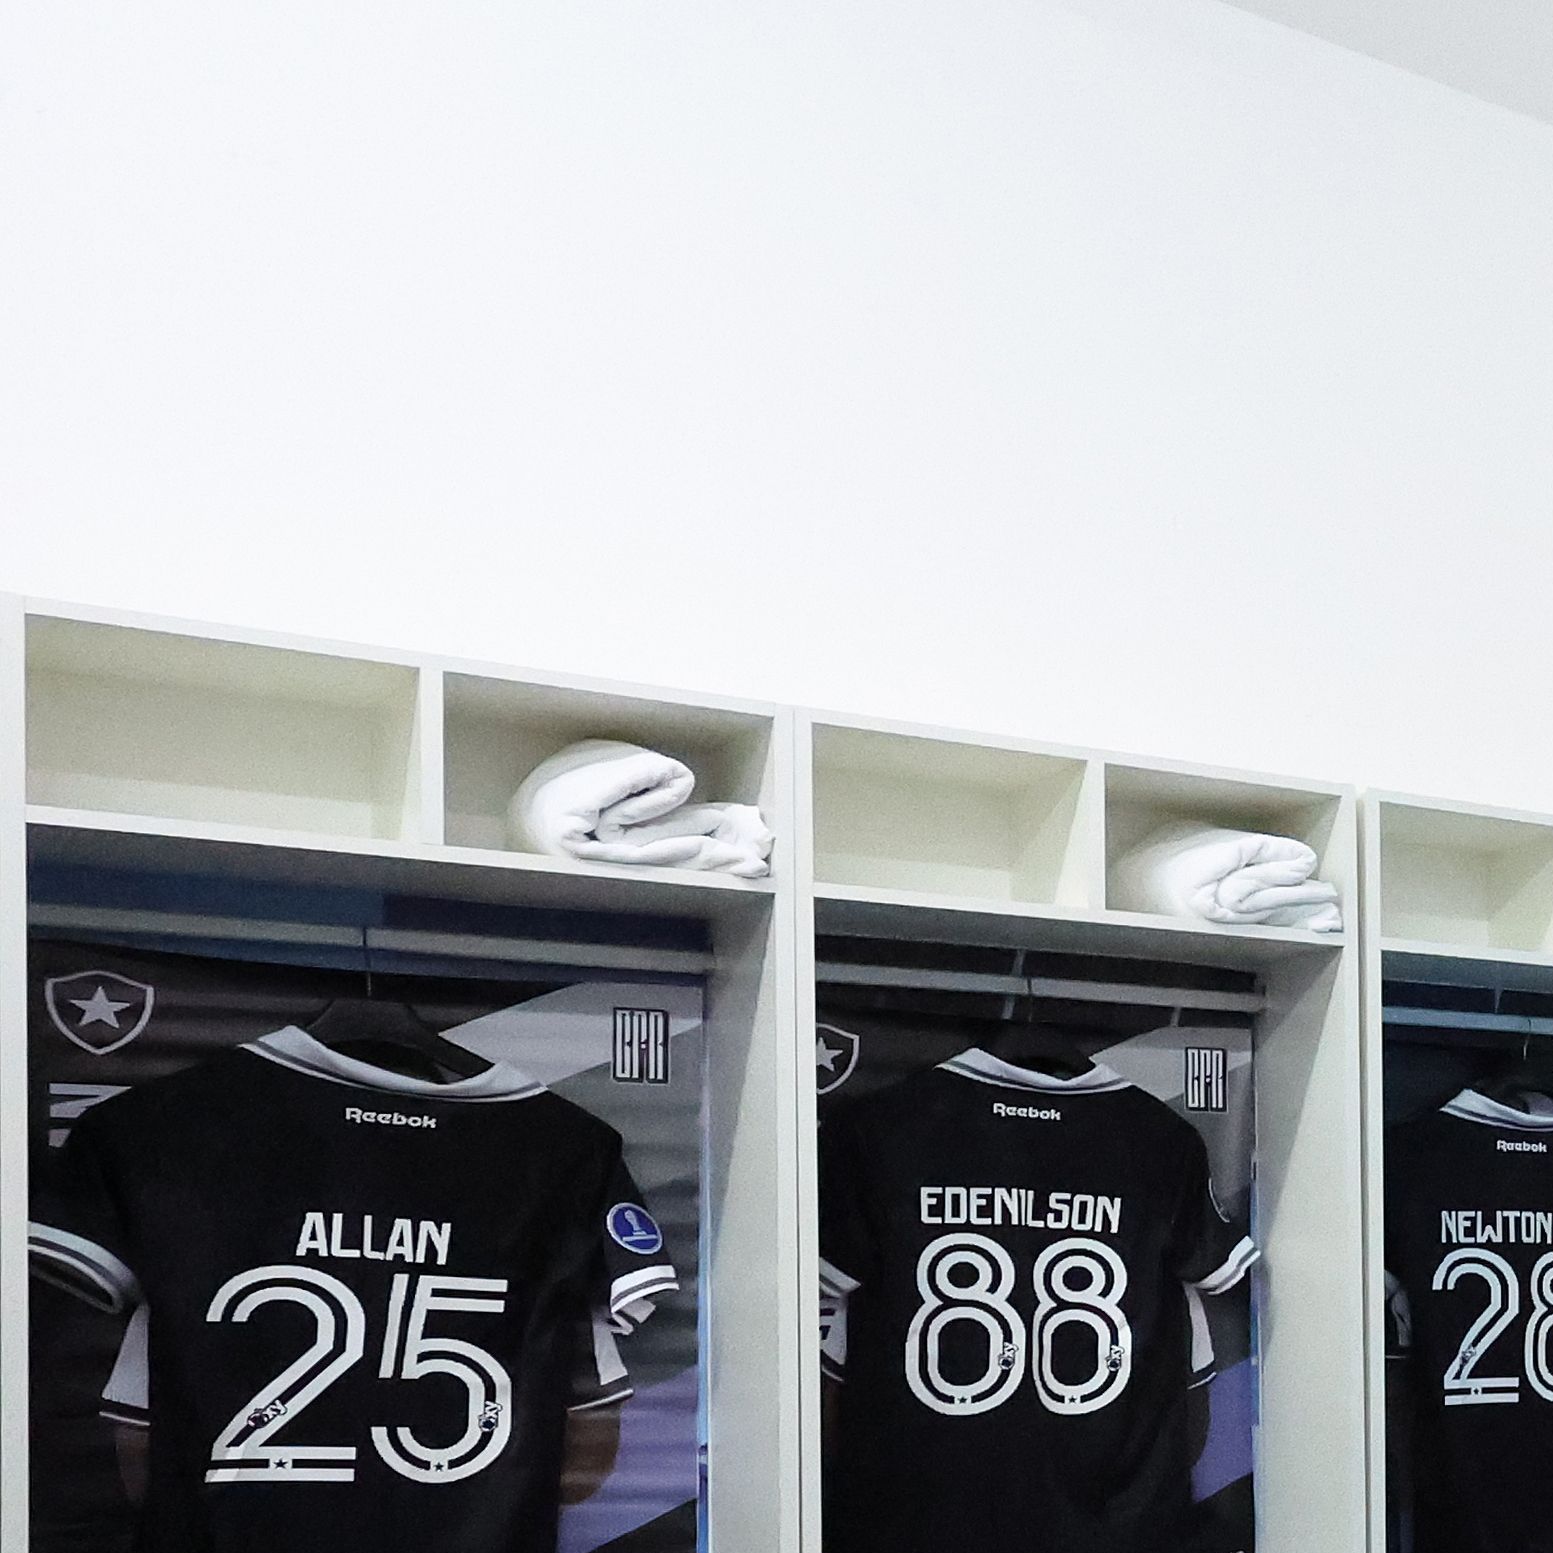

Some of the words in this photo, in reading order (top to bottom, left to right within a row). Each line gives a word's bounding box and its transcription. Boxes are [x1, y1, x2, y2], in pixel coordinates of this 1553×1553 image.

[345, 1107, 437, 1129] Reebok
[993, 1102, 1061, 1121] Reebok
[1496, 1139, 1547, 1154] Reebok
[920, 1186, 1122, 1234] EDENILSON
[1441, 1210, 1553, 1246] NEWTON
[295, 1211, 453, 1265] ALLAN
[904, 1231, 1133, 1416] 88
[204, 1264, 513, 1484] 25
